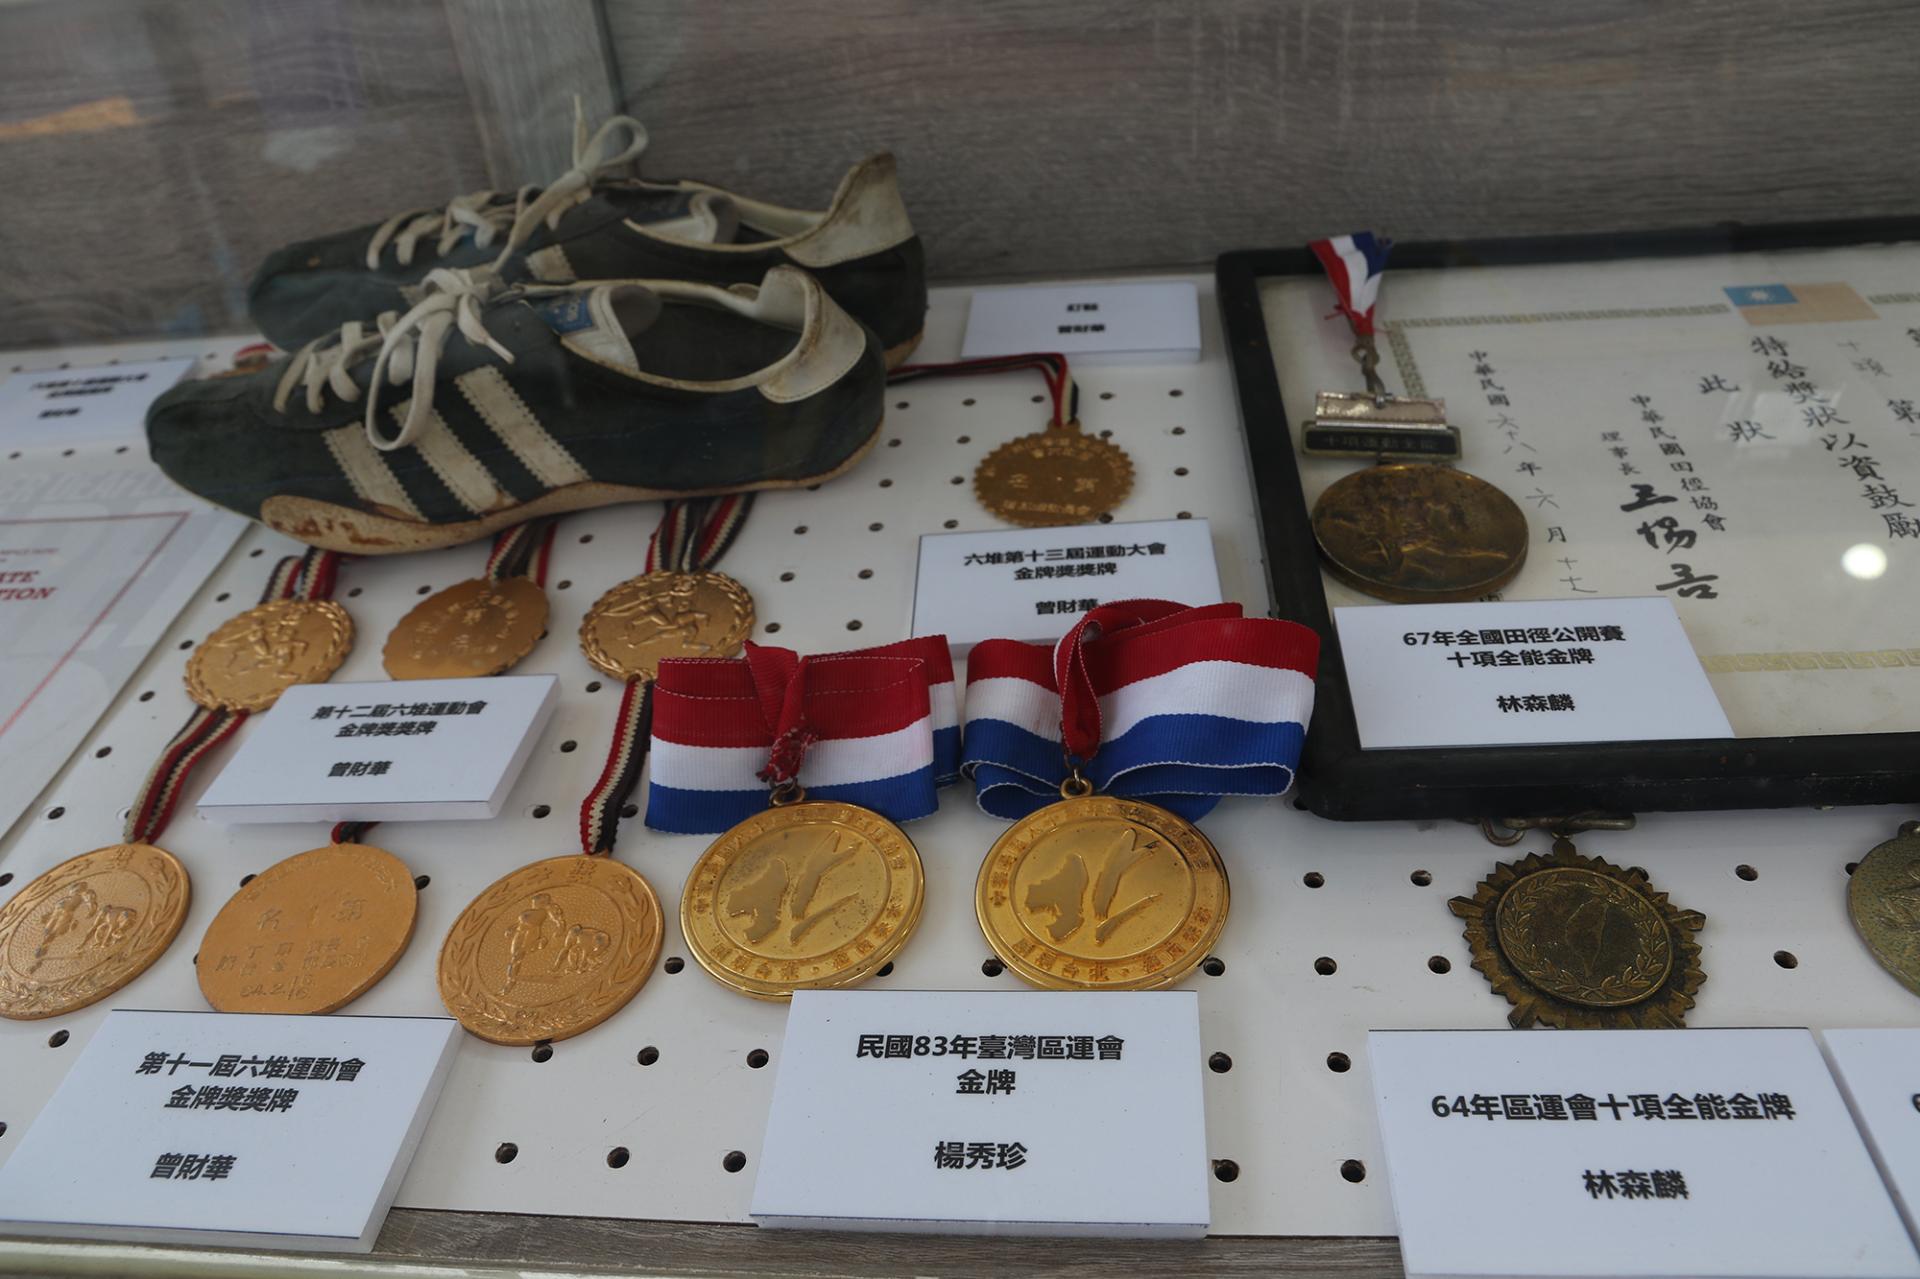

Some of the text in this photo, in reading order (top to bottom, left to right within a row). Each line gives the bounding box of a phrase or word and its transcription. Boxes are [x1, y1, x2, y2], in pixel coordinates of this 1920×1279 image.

[964, 542, 1166, 566] 六堆第十三屆運動大會
[1014, 562, 1118, 581] 金牌獎獎牌
[1402, 624, 1626, 648] 67年全國田徑公開賽
[1446, 647, 1596, 668] 十項全能金牌
[311, 700, 488, 720] 第十二屆六堆運動會
[1496, 693, 1576, 713] 林森麟
[334, 720, 438, 738] 金牌獎獎牌
[327, 760, 393, 778] 曾財華
[855, 1033, 1125, 1061] 民國83年臺灣區運會
[135, 1051, 366, 1083] 第十一屆六堆運動會
[955, 1068, 1017, 1096] 金牌
[163, 1084, 300, 1114] 金牌獎獎牌
[1430, 1091, 1797, 1122] 64年區運會十項全能金牌
[149, 1152, 238, 1182] 曾財華
[933, 1140, 1028, 1171] 楊秀珍
[1581, 1168, 1690, 1201] 林森麟
